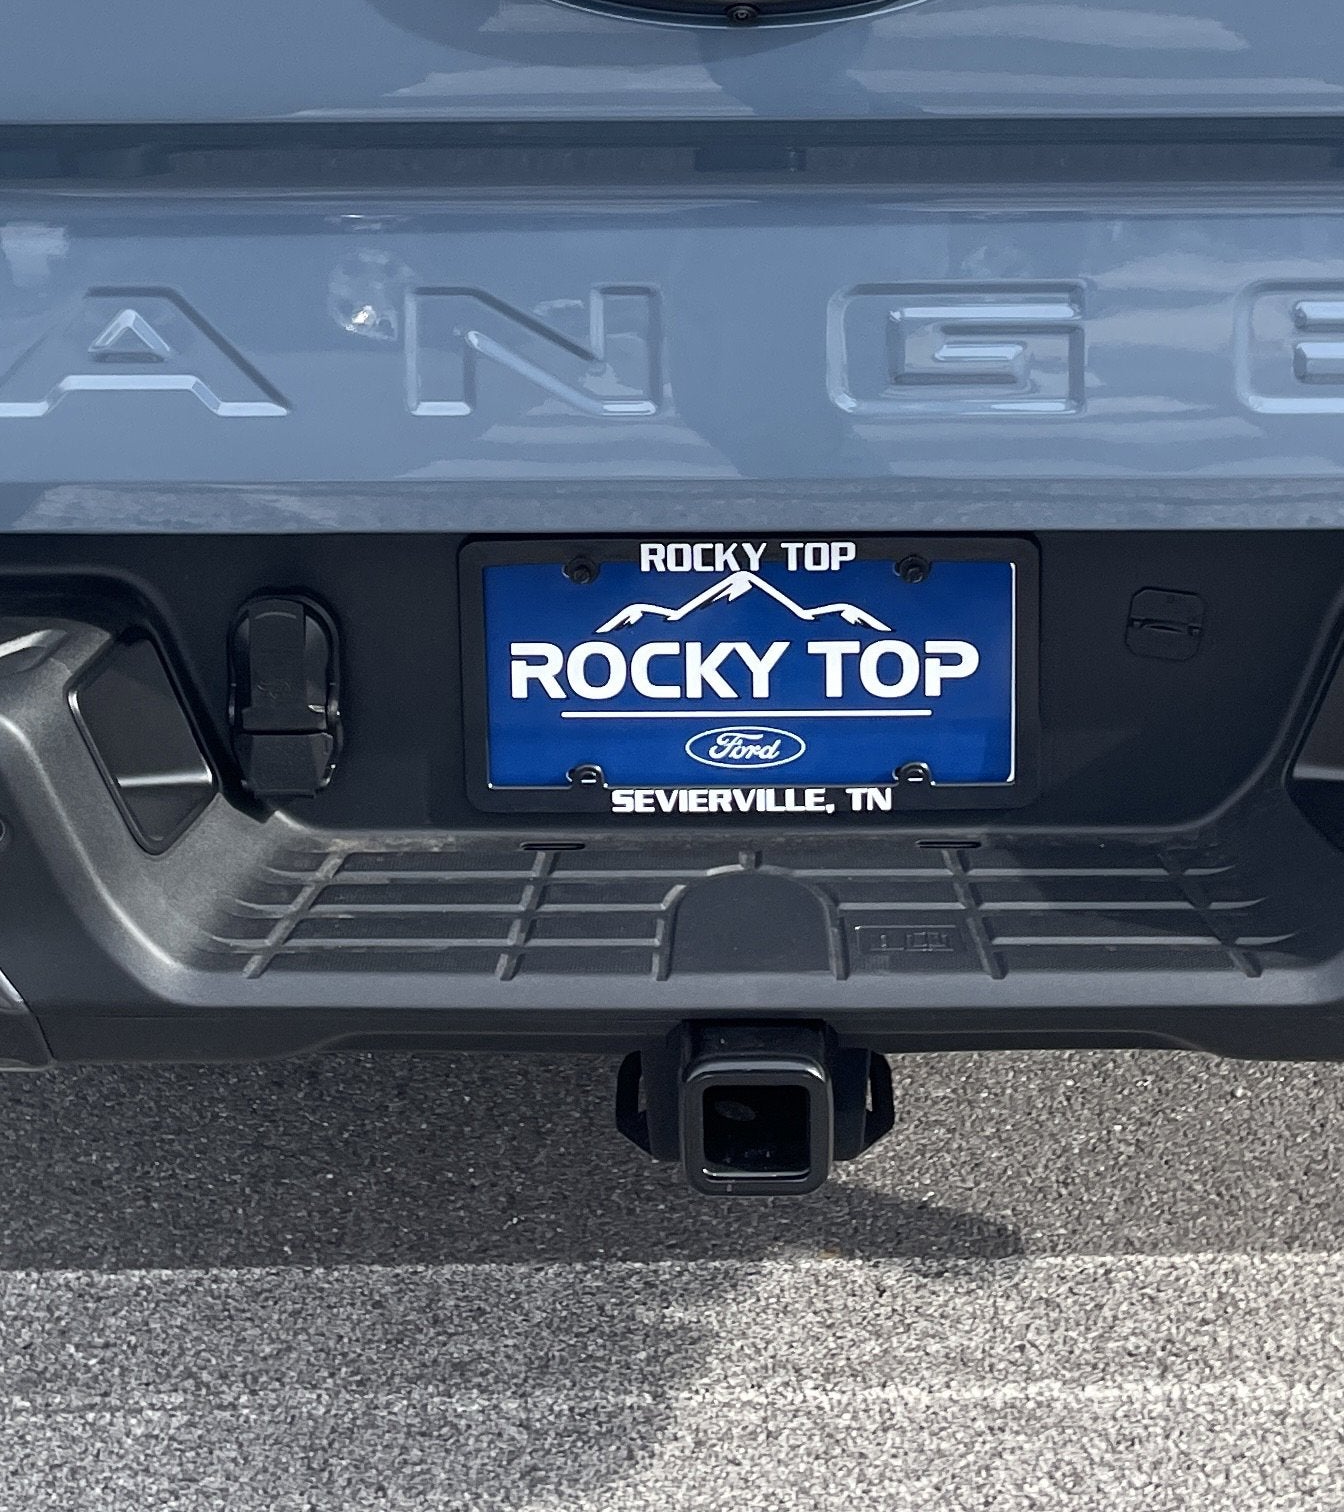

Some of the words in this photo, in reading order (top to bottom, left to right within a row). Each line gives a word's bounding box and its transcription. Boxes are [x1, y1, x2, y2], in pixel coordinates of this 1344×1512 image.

[640, 543, 767, 572] ROCKY
[780, 541, 856, 571] TOP
[510, 641, 790, 700] ROCKY
[807, 639, 980, 698] TOP
[708, 732, 782, 760] Ford
[611, 788, 834, 814] SEVIERVILLE,
[846, 787, 892, 811] TN
